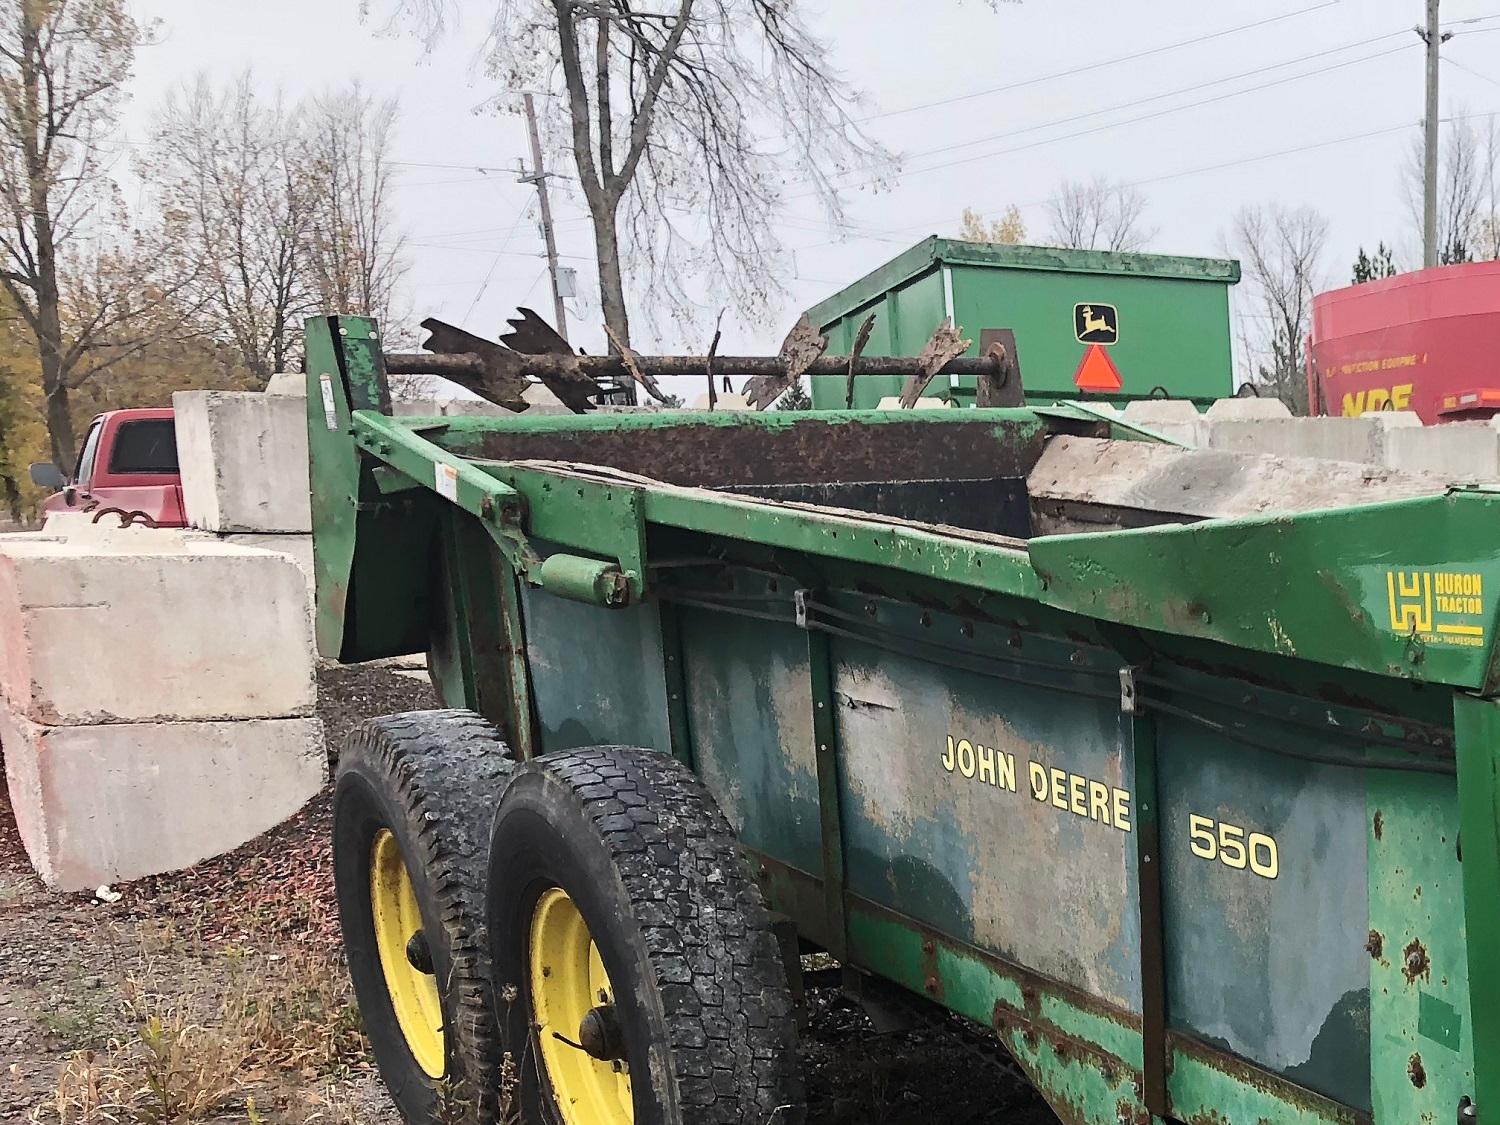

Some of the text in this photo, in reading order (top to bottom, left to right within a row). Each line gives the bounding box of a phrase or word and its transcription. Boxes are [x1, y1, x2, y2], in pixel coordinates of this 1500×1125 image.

[1434, 572, 1482, 596] HURON
[1435, 596, 1483, 615] TRACTOR
[941, 735, 1132, 832] JOHN DEERE
[1189, 813, 1279, 880] 550
